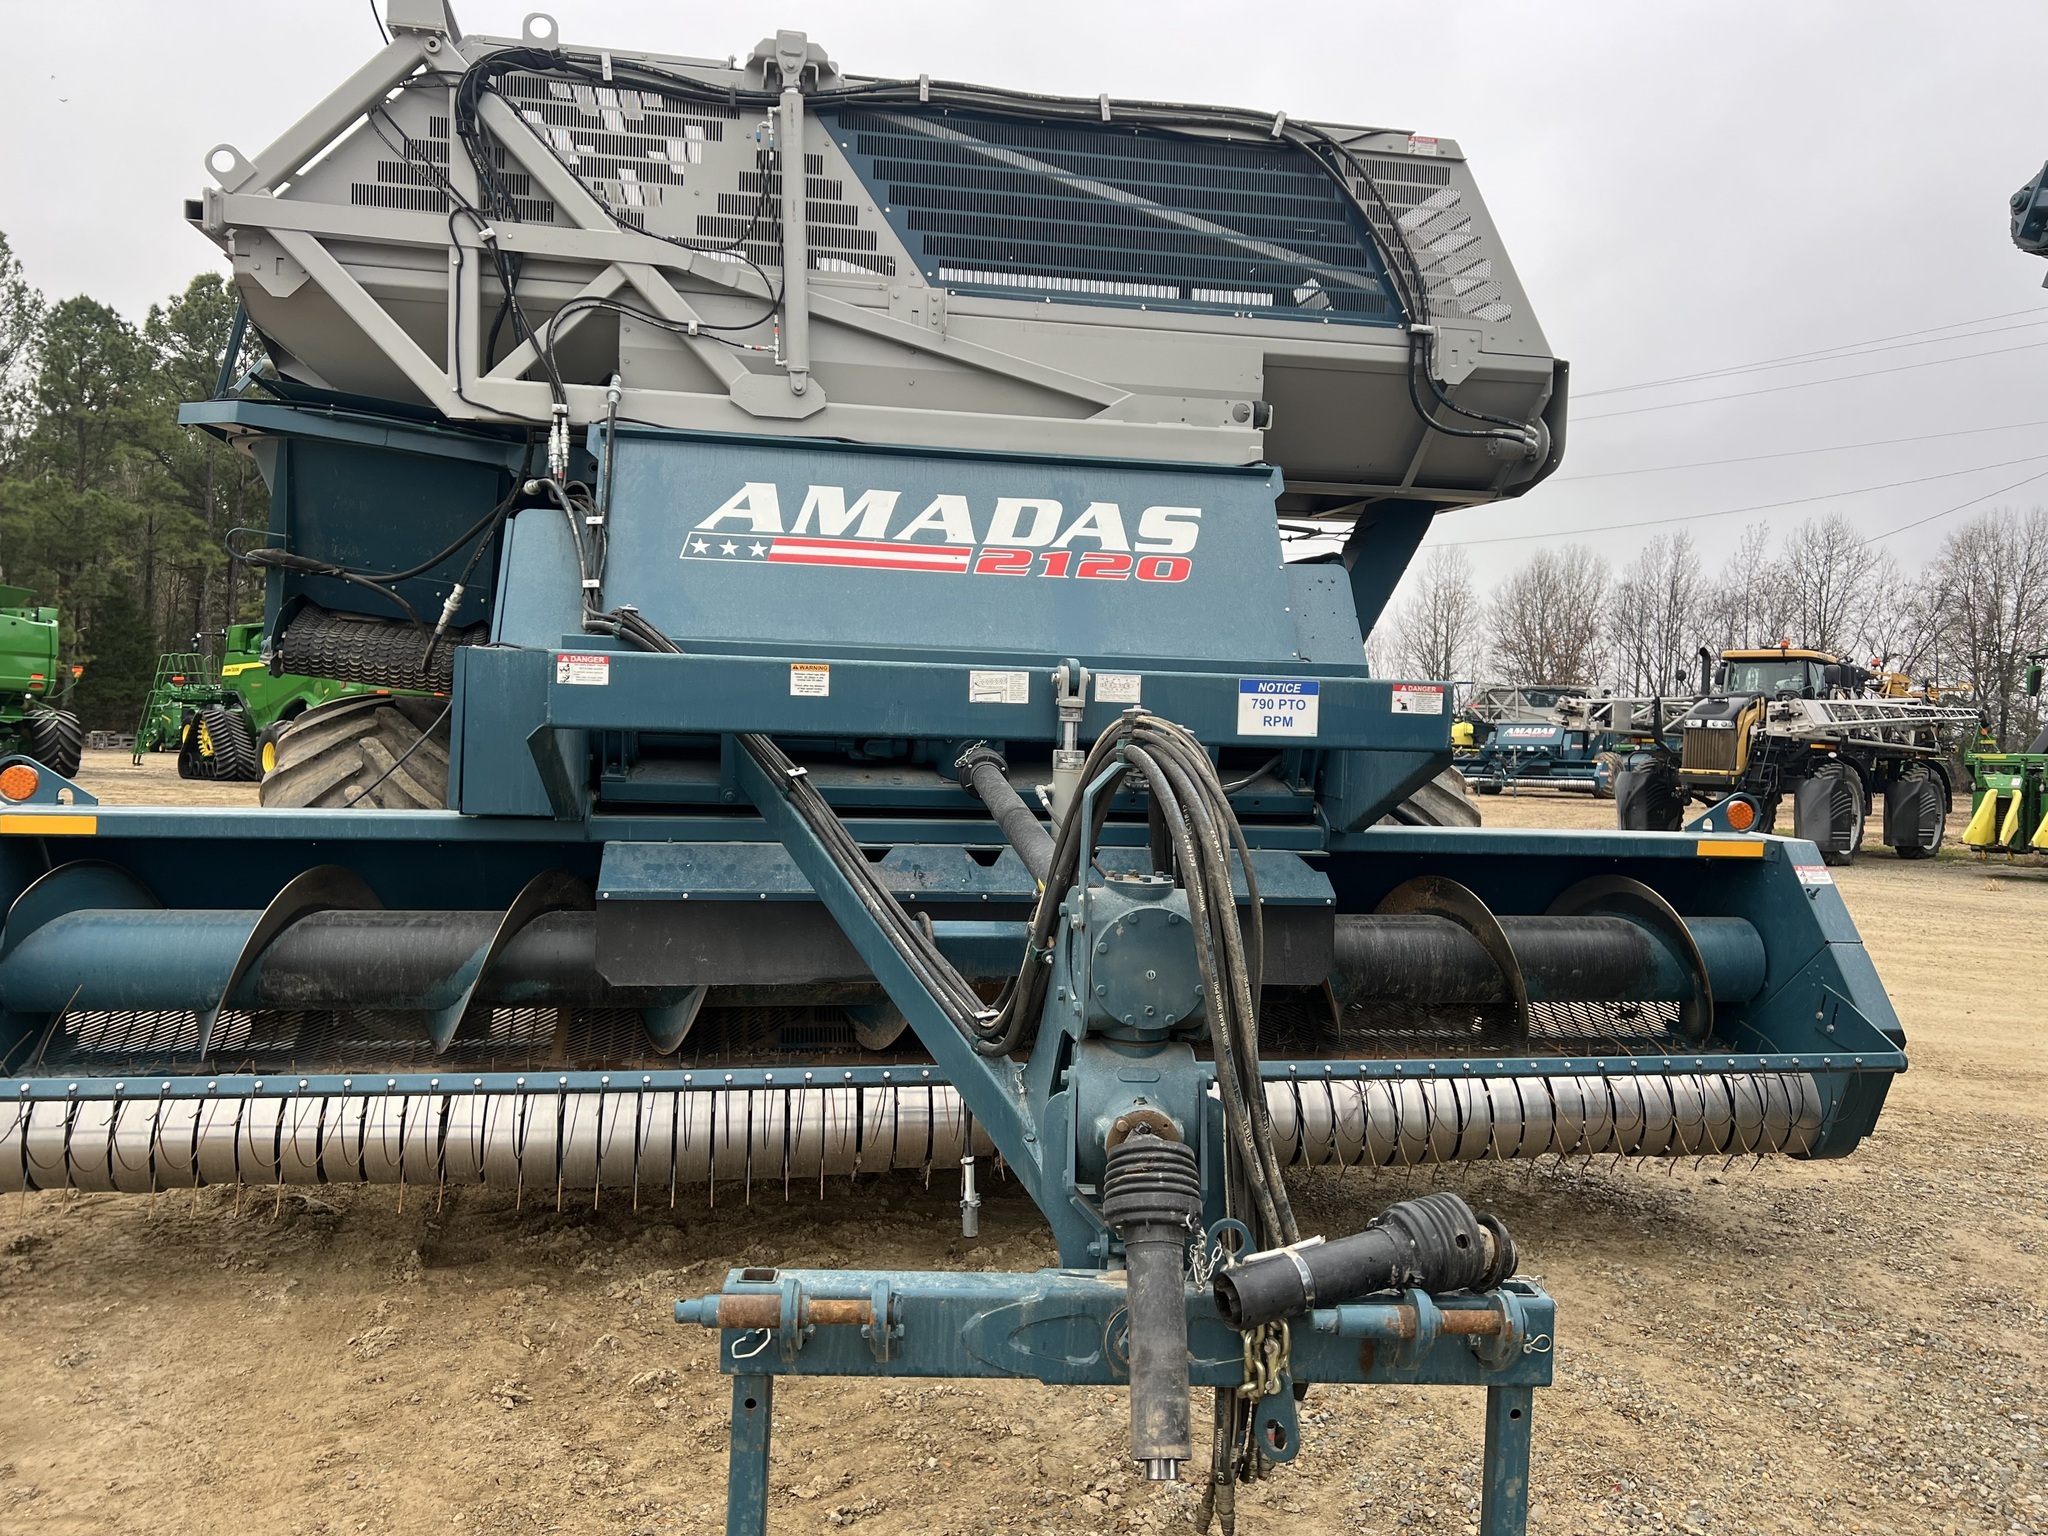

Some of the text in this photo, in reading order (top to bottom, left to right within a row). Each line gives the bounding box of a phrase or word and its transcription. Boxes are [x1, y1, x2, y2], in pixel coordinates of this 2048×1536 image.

[694, 481, 1202, 554] AMADAS
[973, 548, 1193, 583] 2120
[570, 655, 605, 663] DANGER
[1258, 682, 1301, 693] NOTICE
[1251, 698, 1306, 711] 790 PTO
[1263, 715, 1293, 728] RPM
[1183, 834, 1206, 912] Winner EC118-12
[1226, 880, 1235, 907] Winner
